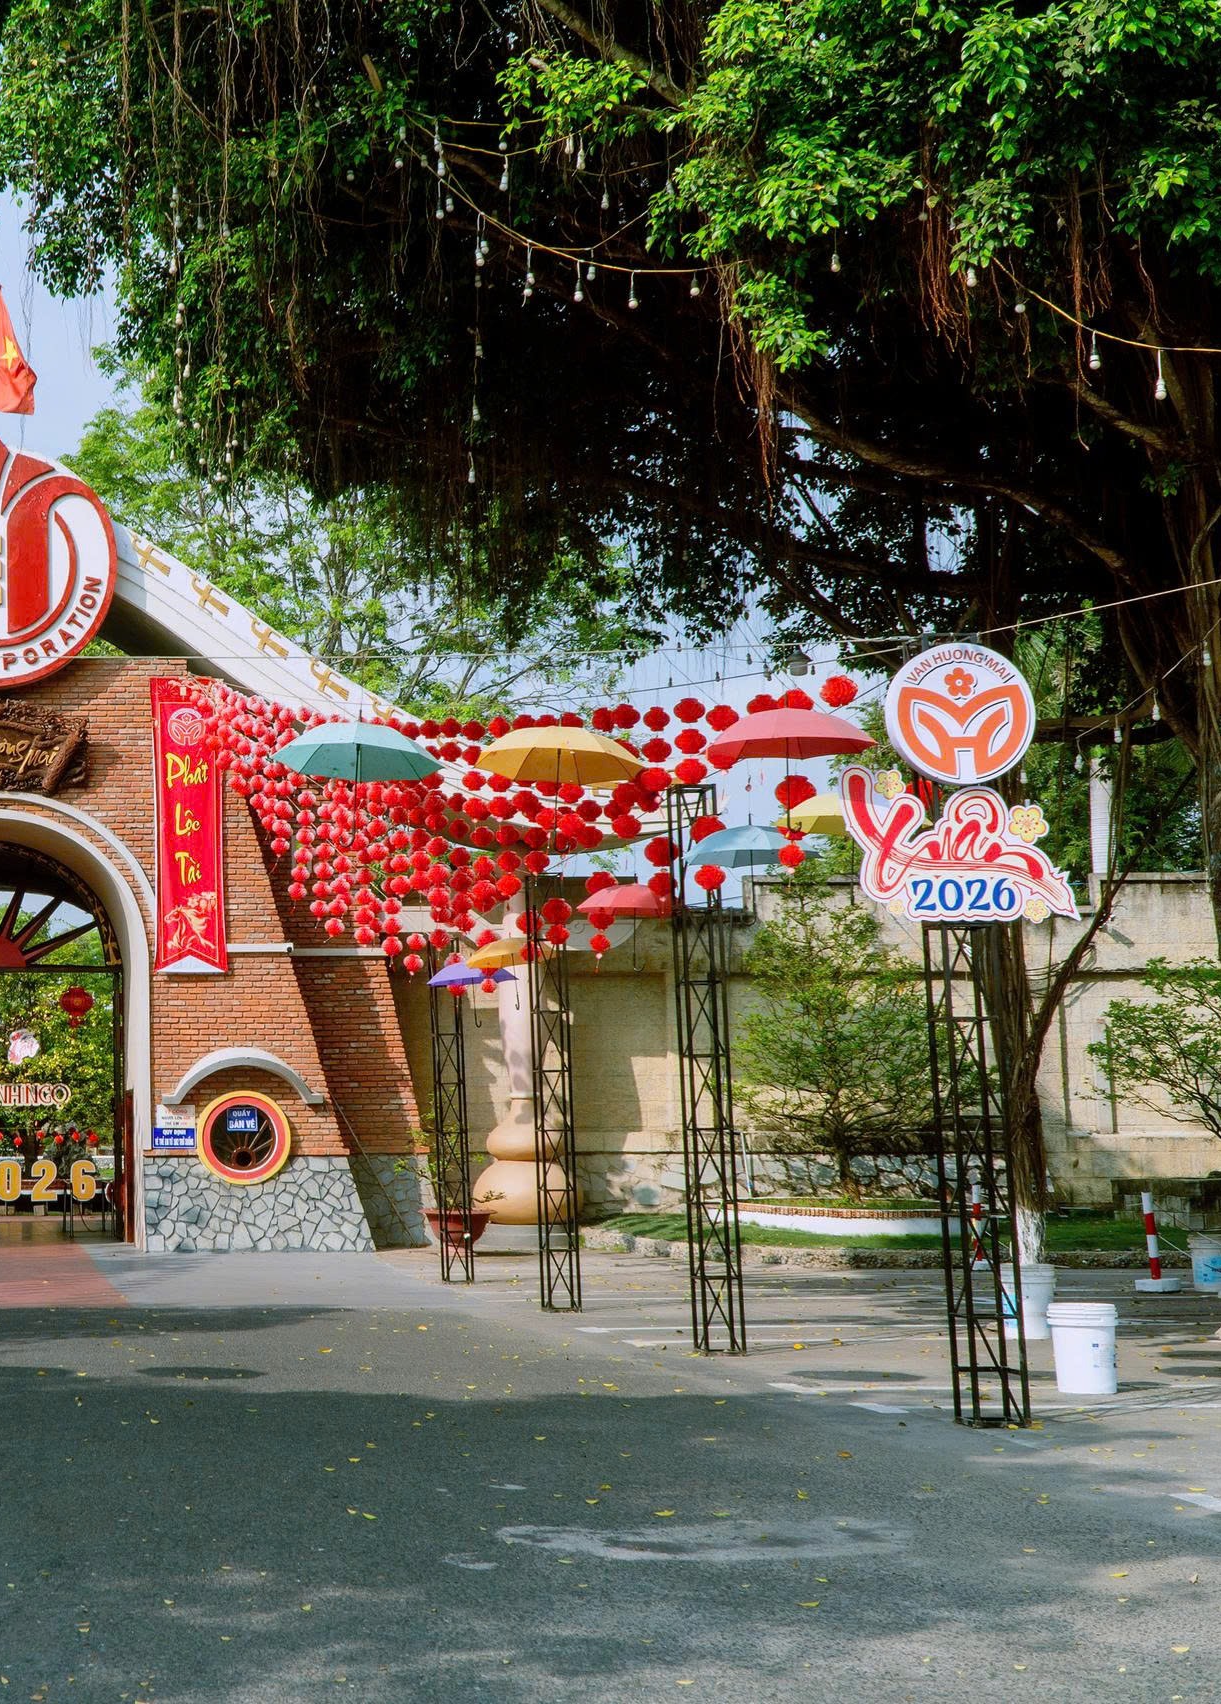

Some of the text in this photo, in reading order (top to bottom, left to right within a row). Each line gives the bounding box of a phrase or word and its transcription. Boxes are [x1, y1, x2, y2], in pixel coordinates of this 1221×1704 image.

[19, 745, 60, 775] Mai
[165, 751, 209, 887] Phát Lộc Tài
[911, 877, 1017, 913] 2026
[228, 1119, 245, 1129] BÁN
